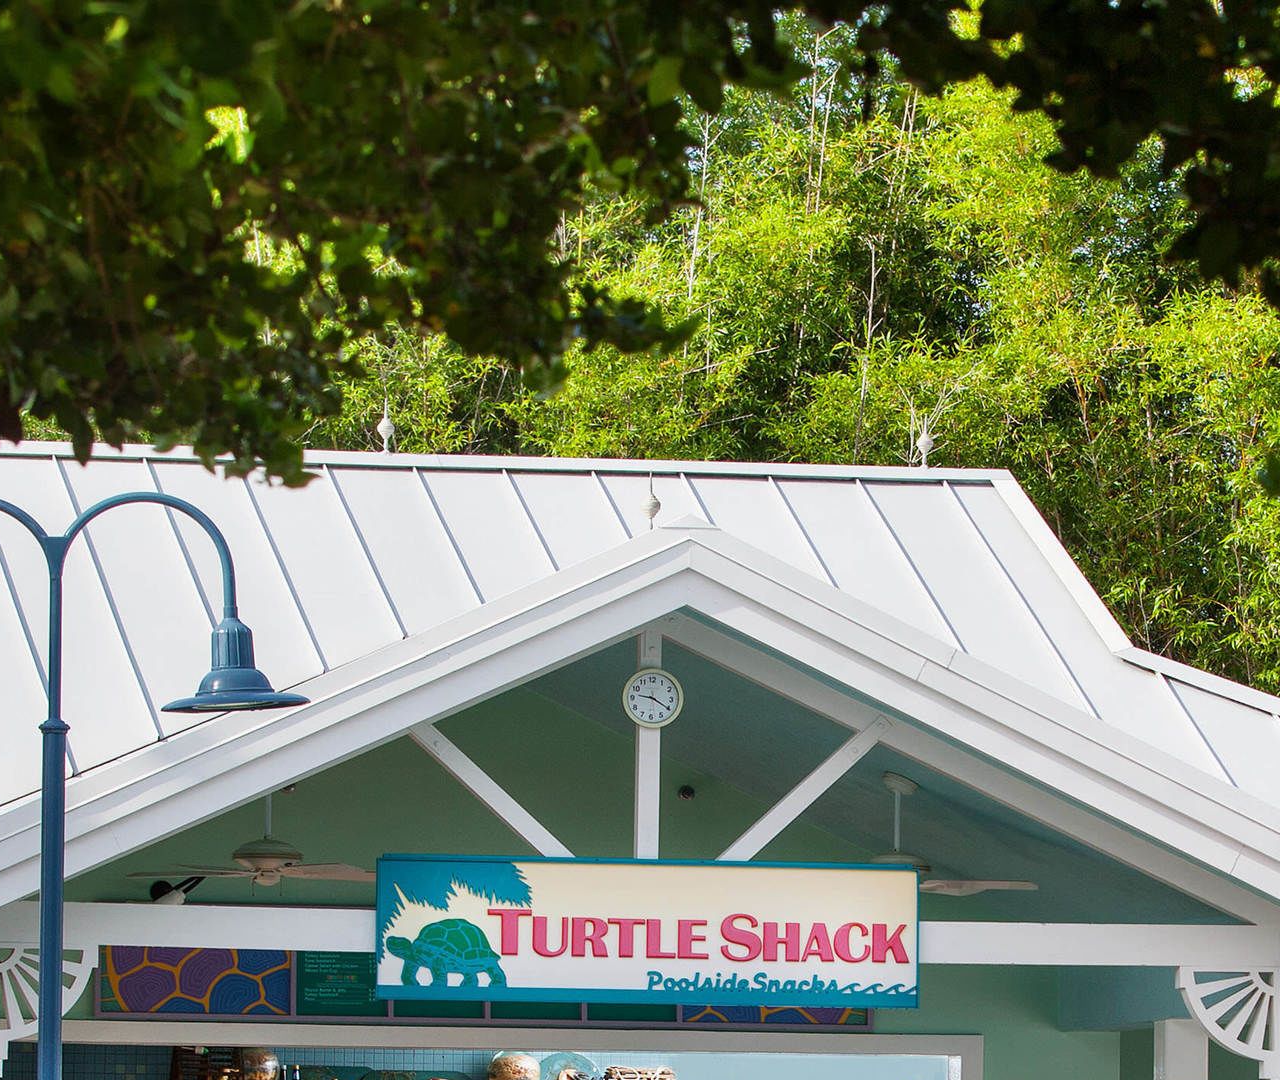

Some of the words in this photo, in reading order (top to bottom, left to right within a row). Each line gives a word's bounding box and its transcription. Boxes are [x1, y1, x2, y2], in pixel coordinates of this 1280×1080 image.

[487, 908, 710, 960] TURTLE
[720, 913, 911, 965] SHACK
[646, 971, 749, 993] Poolside
[751, 972, 838, 995] Snacks
